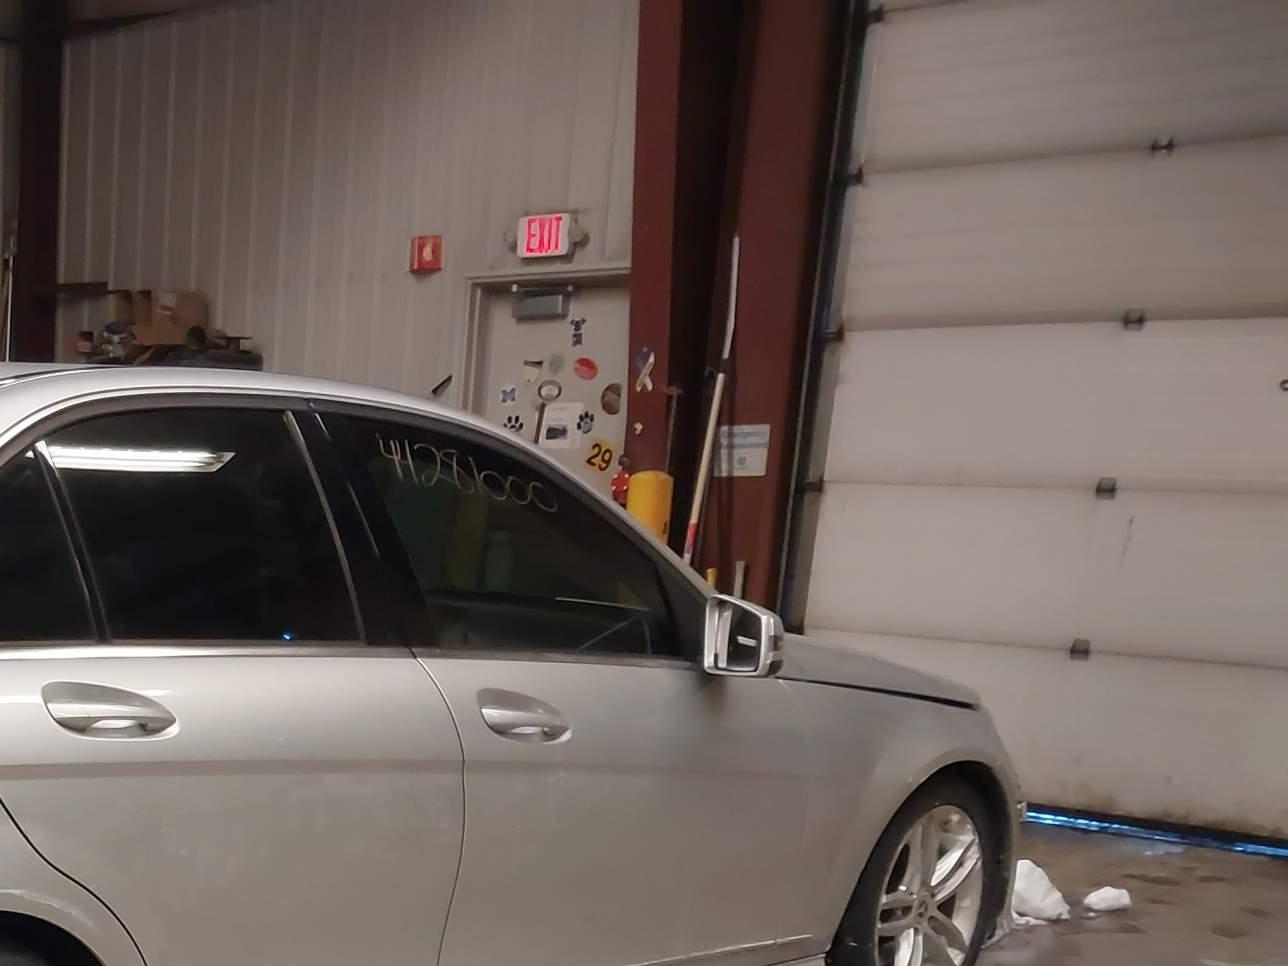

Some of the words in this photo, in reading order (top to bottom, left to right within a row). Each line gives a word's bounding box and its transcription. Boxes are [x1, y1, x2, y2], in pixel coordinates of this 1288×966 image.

[527, 216, 562, 253] EXIT
[375, 433, 559, 513] 44281000
[586, 443, 613, 472] 29
